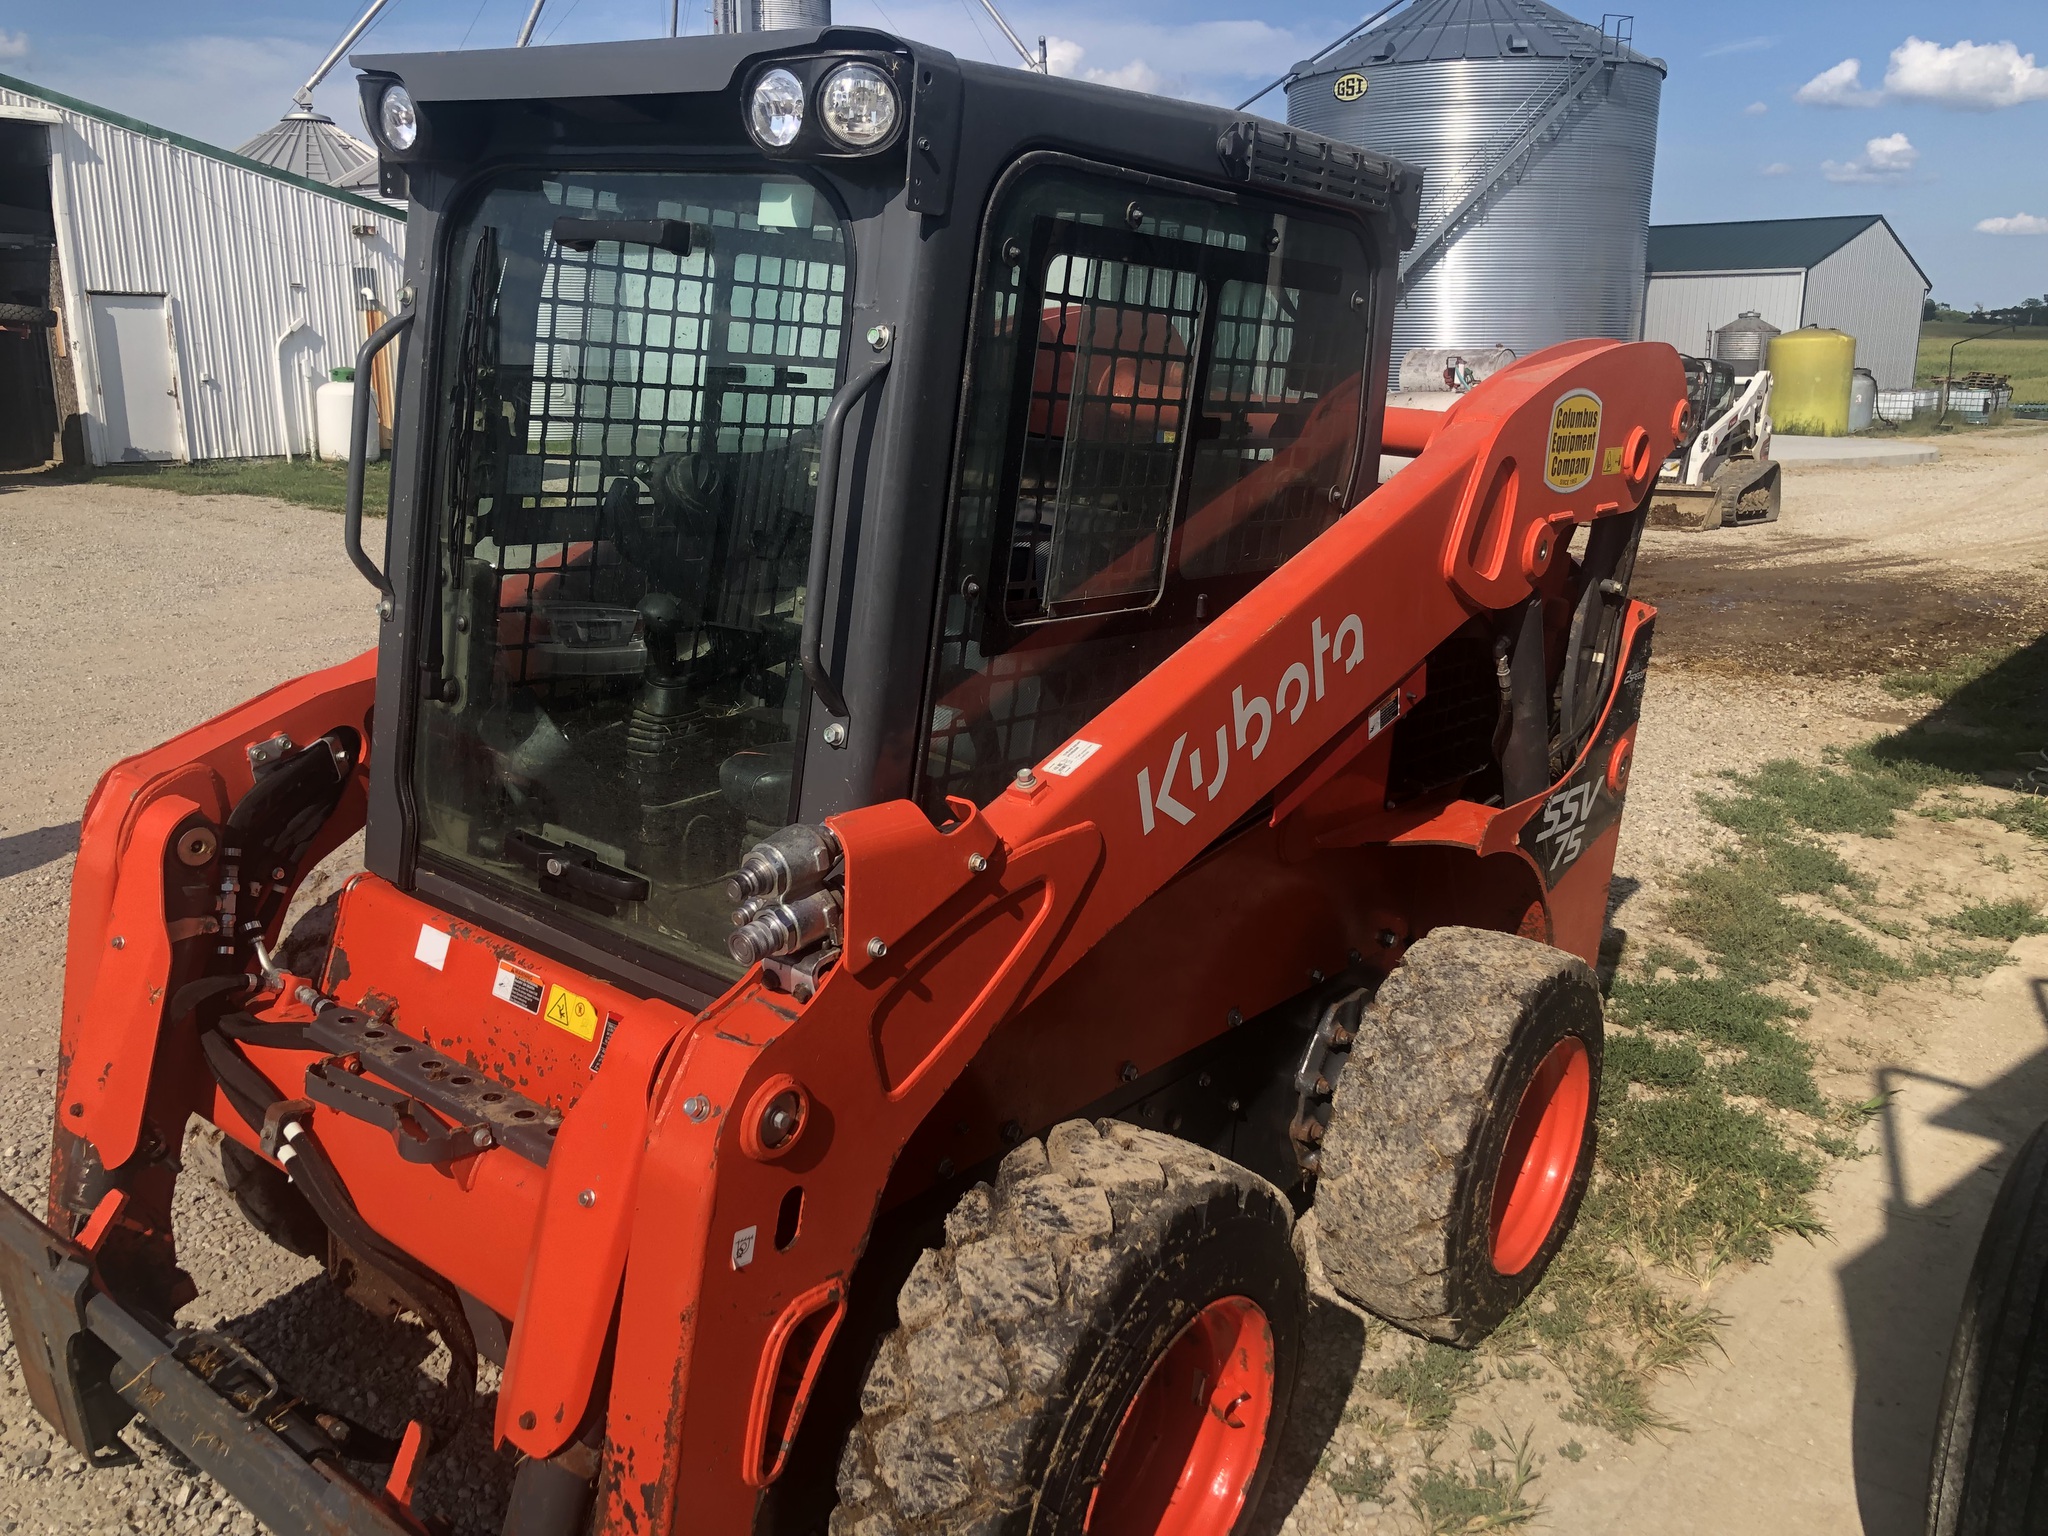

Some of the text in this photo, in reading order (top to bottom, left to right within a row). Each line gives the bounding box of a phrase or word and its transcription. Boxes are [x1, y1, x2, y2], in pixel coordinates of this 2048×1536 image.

[1337, 78, 1364, 97] GSI
[1556, 408, 1598, 429] Columbus
[1551, 432, 1597, 455] Equipment
[1551, 456, 1591, 477] Company
[1137, 613, 1364, 836] Kubota
[1535, 775, 1605, 843] SSV
[1549, 824, 1586, 871] 75
